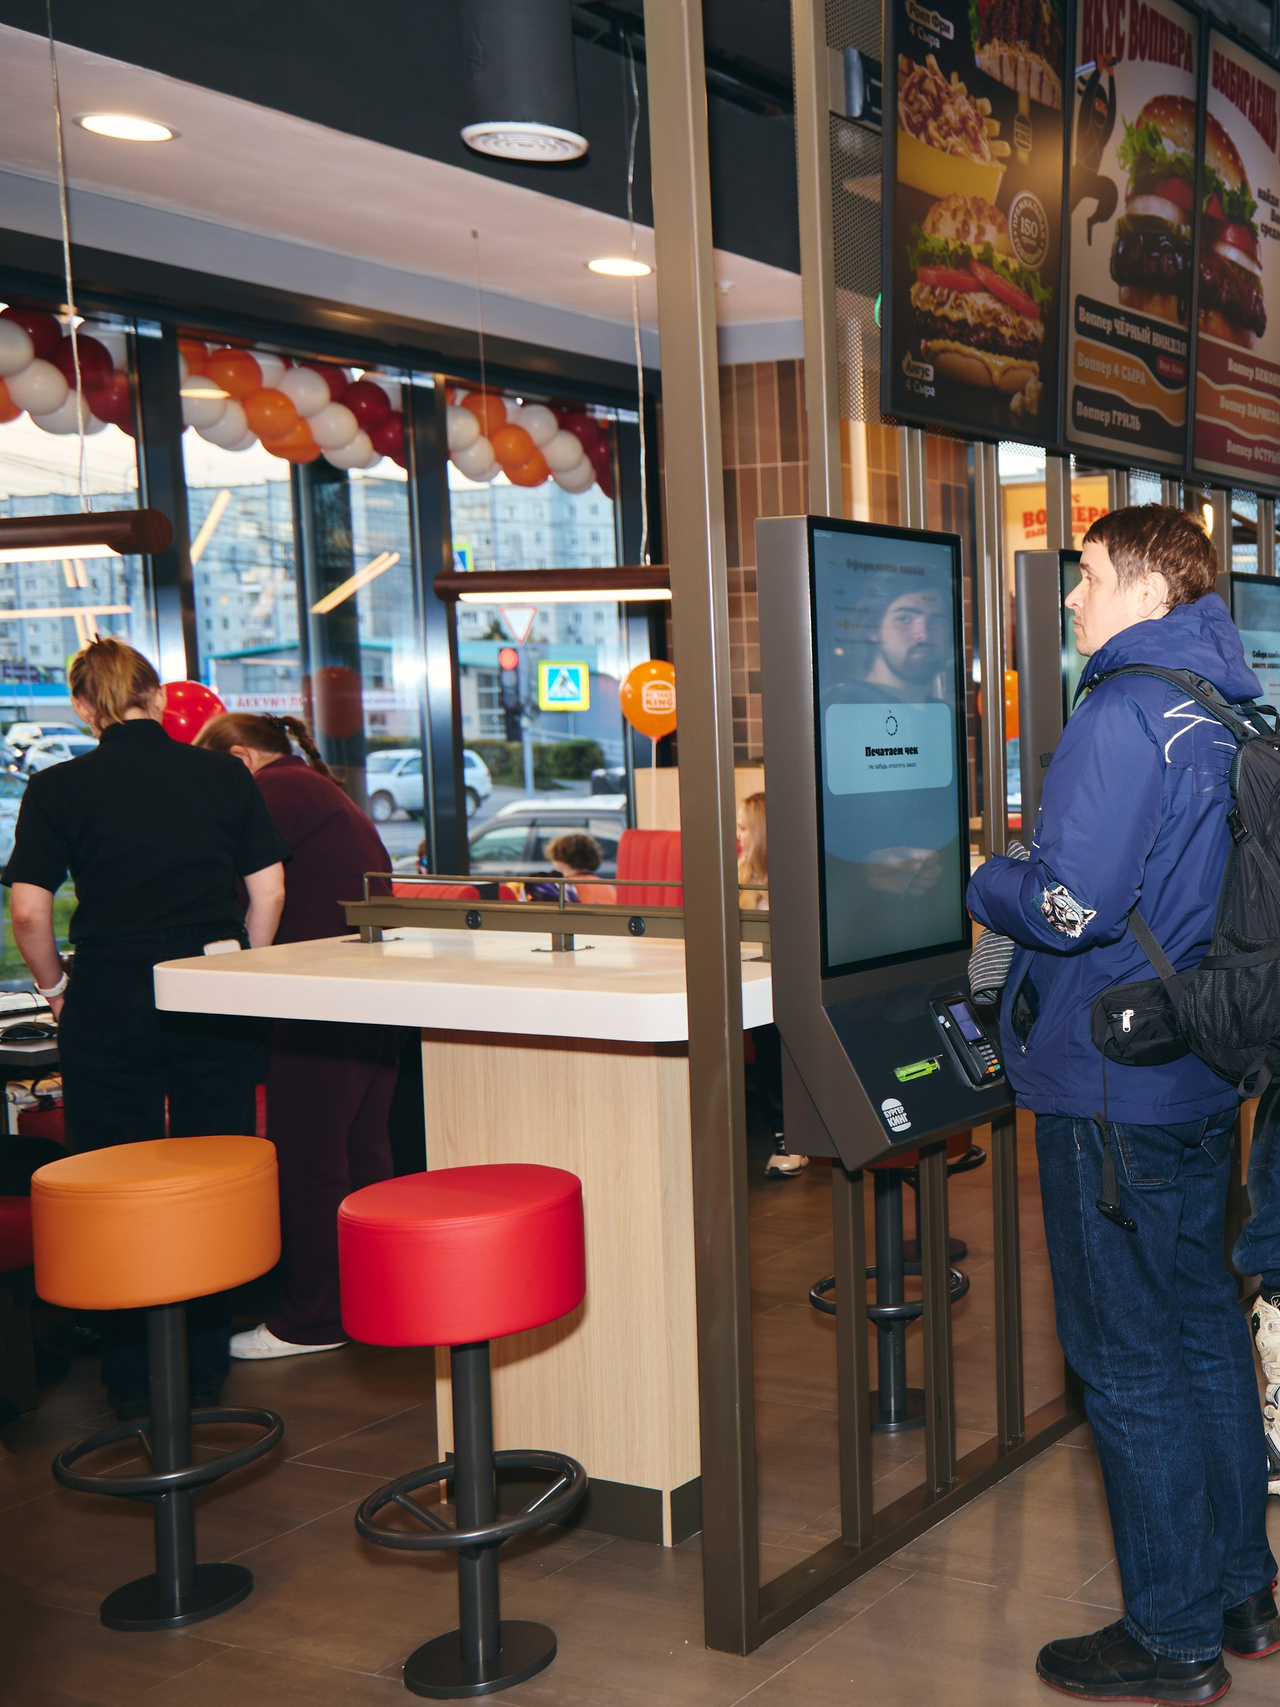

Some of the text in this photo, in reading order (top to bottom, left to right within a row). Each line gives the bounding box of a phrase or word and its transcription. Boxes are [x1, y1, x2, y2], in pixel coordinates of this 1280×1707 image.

[909, 23, 941, 48] 4 Сыра
[1082, 0, 1194, 74] ВКУС ВОППЕРА
[1212, 50, 1278, 154] ВЫБИРАЕШЬ
[1020, 216, 1039, 239] 150
[1078, 306, 1188, 357] Воппер ЧЁРНЫЙ НИНДЗЯ
[906, 360, 931, 378] Ангус
[1077, 351, 1146, 386] Воппер 4 СЫРА
[1228, 357, 1254, 382] Воппер
[905, 380, 936, 398] 4 Сыра
[1076, 400, 1141, 431] Воппер ГРИЛЬ
[1219, 394, 1247, 418] Воппер
[1226, 439, 1253, 461] Воппер
[865, 746, 919, 757] Печатаем чек
[883, 1106, 905, 1118] БУРГЕР
[887, 1113, 909, 1127] КИНГ
